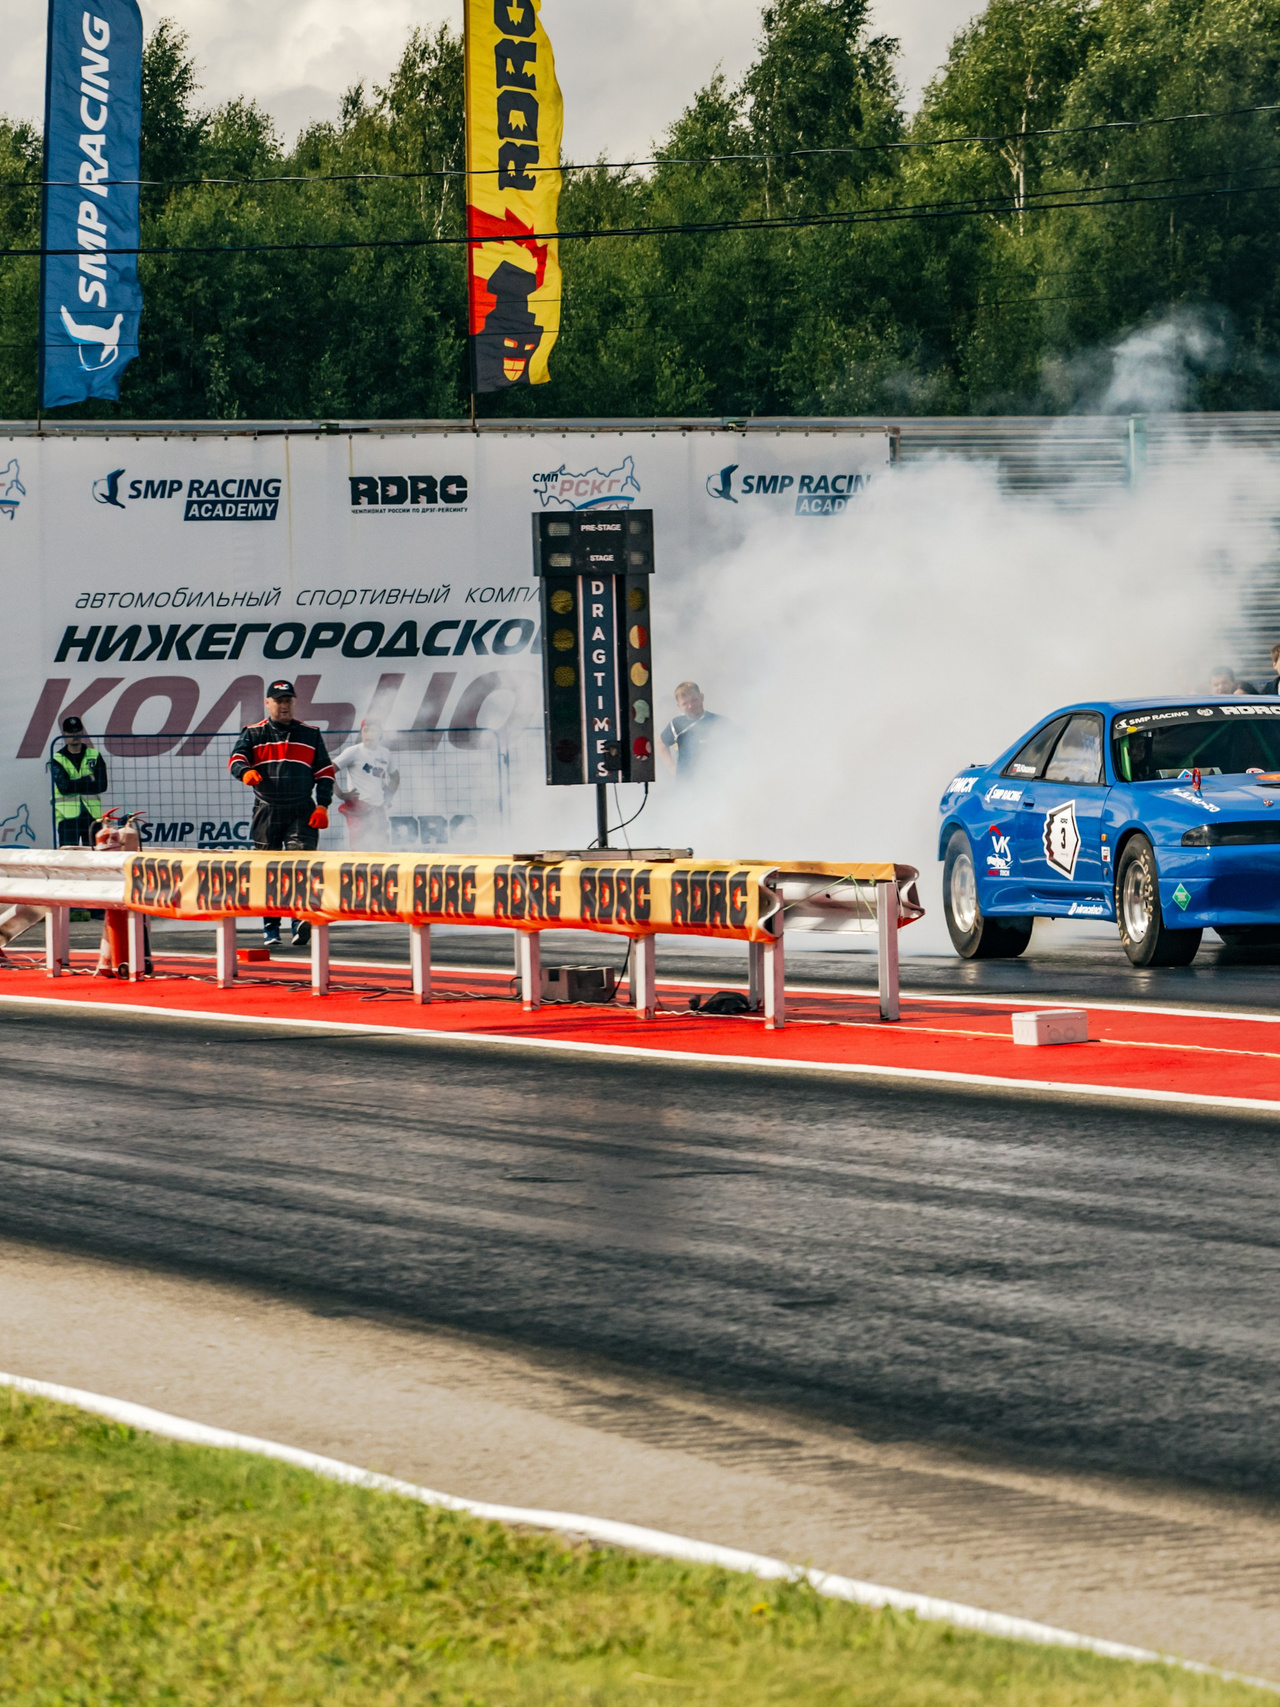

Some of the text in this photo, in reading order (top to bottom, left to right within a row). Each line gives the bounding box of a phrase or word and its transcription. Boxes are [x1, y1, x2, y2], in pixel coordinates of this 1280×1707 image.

[494, 0, 541, 191] RDRC
[77, 11, 111, 308] SMP RACING
[128, 479, 282, 499] SMP RACING
[349, 475, 468, 505] RDRC
[533, 473, 559, 483] СМП
[559, 480, 621, 497] РСКГ
[741, 475, 871, 494] SMP RACIN
[188, 503, 276, 517] ACADEMY
[580, 524, 622, 532] PRE-STAGE
[75, 587, 282, 609] автомобильный
[296, 584, 451, 609] спортивный
[1152, 711, 1189, 721] RACING
[140, 822, 254, 842] SMP RAC
[389, 815, 477, 845] DRC
[1060, 827, 1066, 849] 3
[132, 856, 183, 908] RDRC
[197, 860, 251, 911] RDRC
[266, 860, 325, 912] RDRC
[339, 862, 399, 916] RDRC
[413, 864, 476, 919] RDRC
[494, 865, 561, 922] RDRC
[580, 867, 653, 927] RDRC
[671, 869, 749, 930] RDRC
